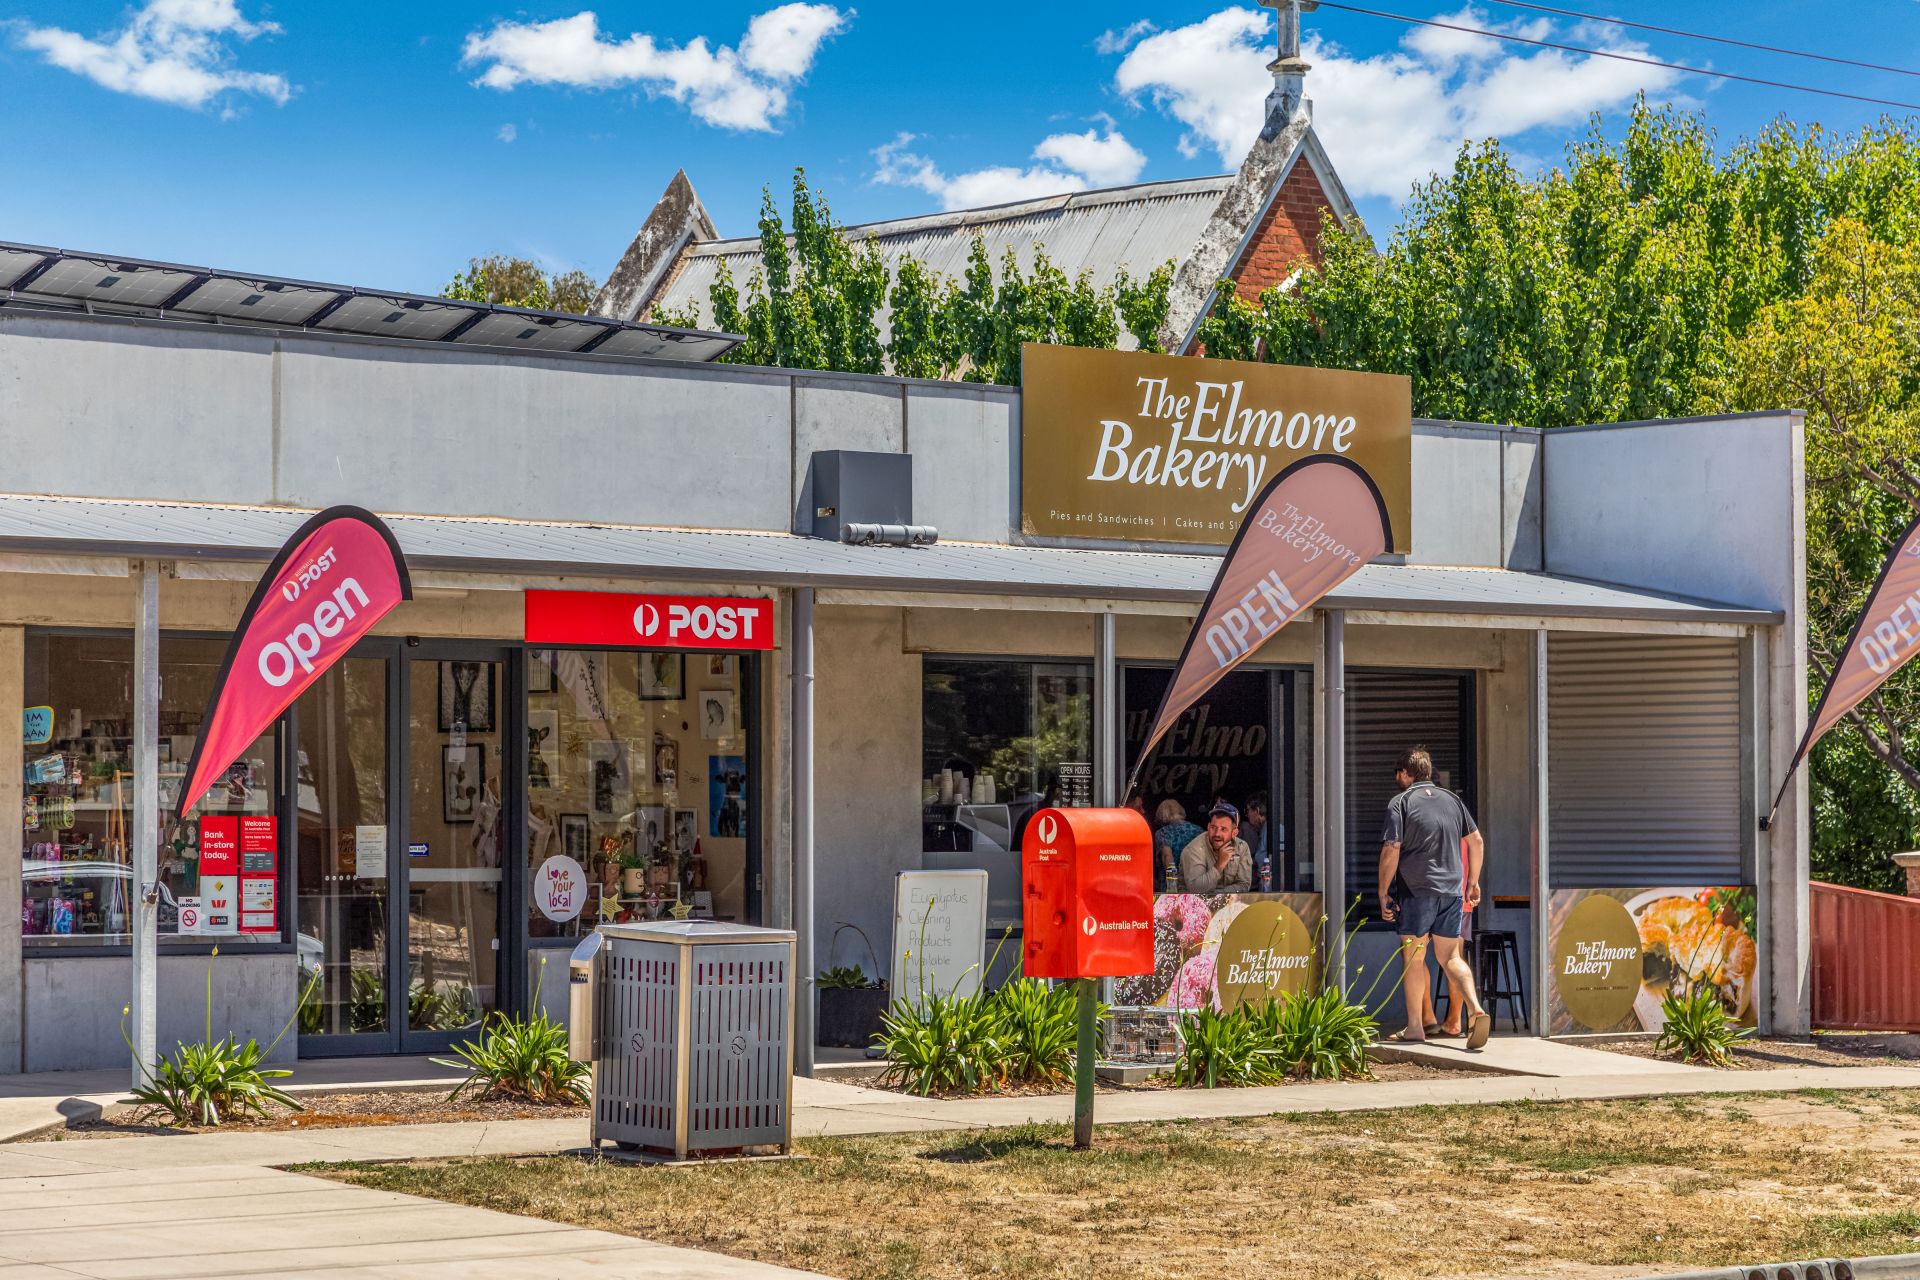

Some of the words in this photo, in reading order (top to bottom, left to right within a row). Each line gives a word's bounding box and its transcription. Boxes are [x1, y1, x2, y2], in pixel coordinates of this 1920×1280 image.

[1136, 376, 1191, 420] The
[1182, 380, 1357, 453] Elmore
[1086, 420, 1267, 514] Bakery
[1050, 510, 1071, 521] Pies
[1075, 511, 1094, 523] and
[1097, 512, 1155, 526] Sandwiches
[1175, 517, 1203, 528] Cakes
[1208, 517, 1225, 529] and
[1257, 508, 1324, 563] Bakery
[1281, 502, 1303, 525] The
[1297, 515, 1361, 567] Elmore
[298, 546, 337, 591] POST
[668, 604, 759, 640] POST
[1205, 569, 1300, 669] OPEN
[258, 577, 371, 687] Open
[1060, 766, 1073, 775] OPEN
[1074, 766, 1091, 775] HOURS
[204, 831, 224, 839] Bank
[204, 841, 234, 849] in-store
[203, 851, 229, 860] today.
[1099, 854, 1108, 862] NO
[1108, 854, 1132, 862] PARKING
[552, 879, 575, 897] your
[548, 892, 571, 908] local
[1099, 920, 1131, 930] Australia
[1131, 920, 1149, 930] Post
[1240, 949, 1258, 963] The
[1255, 948, 1309, 969] Elmore
[1575, 941, 1592, 955] The
[1588, 940, 1637, 961] Elmore
[1225, 962, 1281, 990] Bakery
[1562, 954, 1612, 980] Bakery
